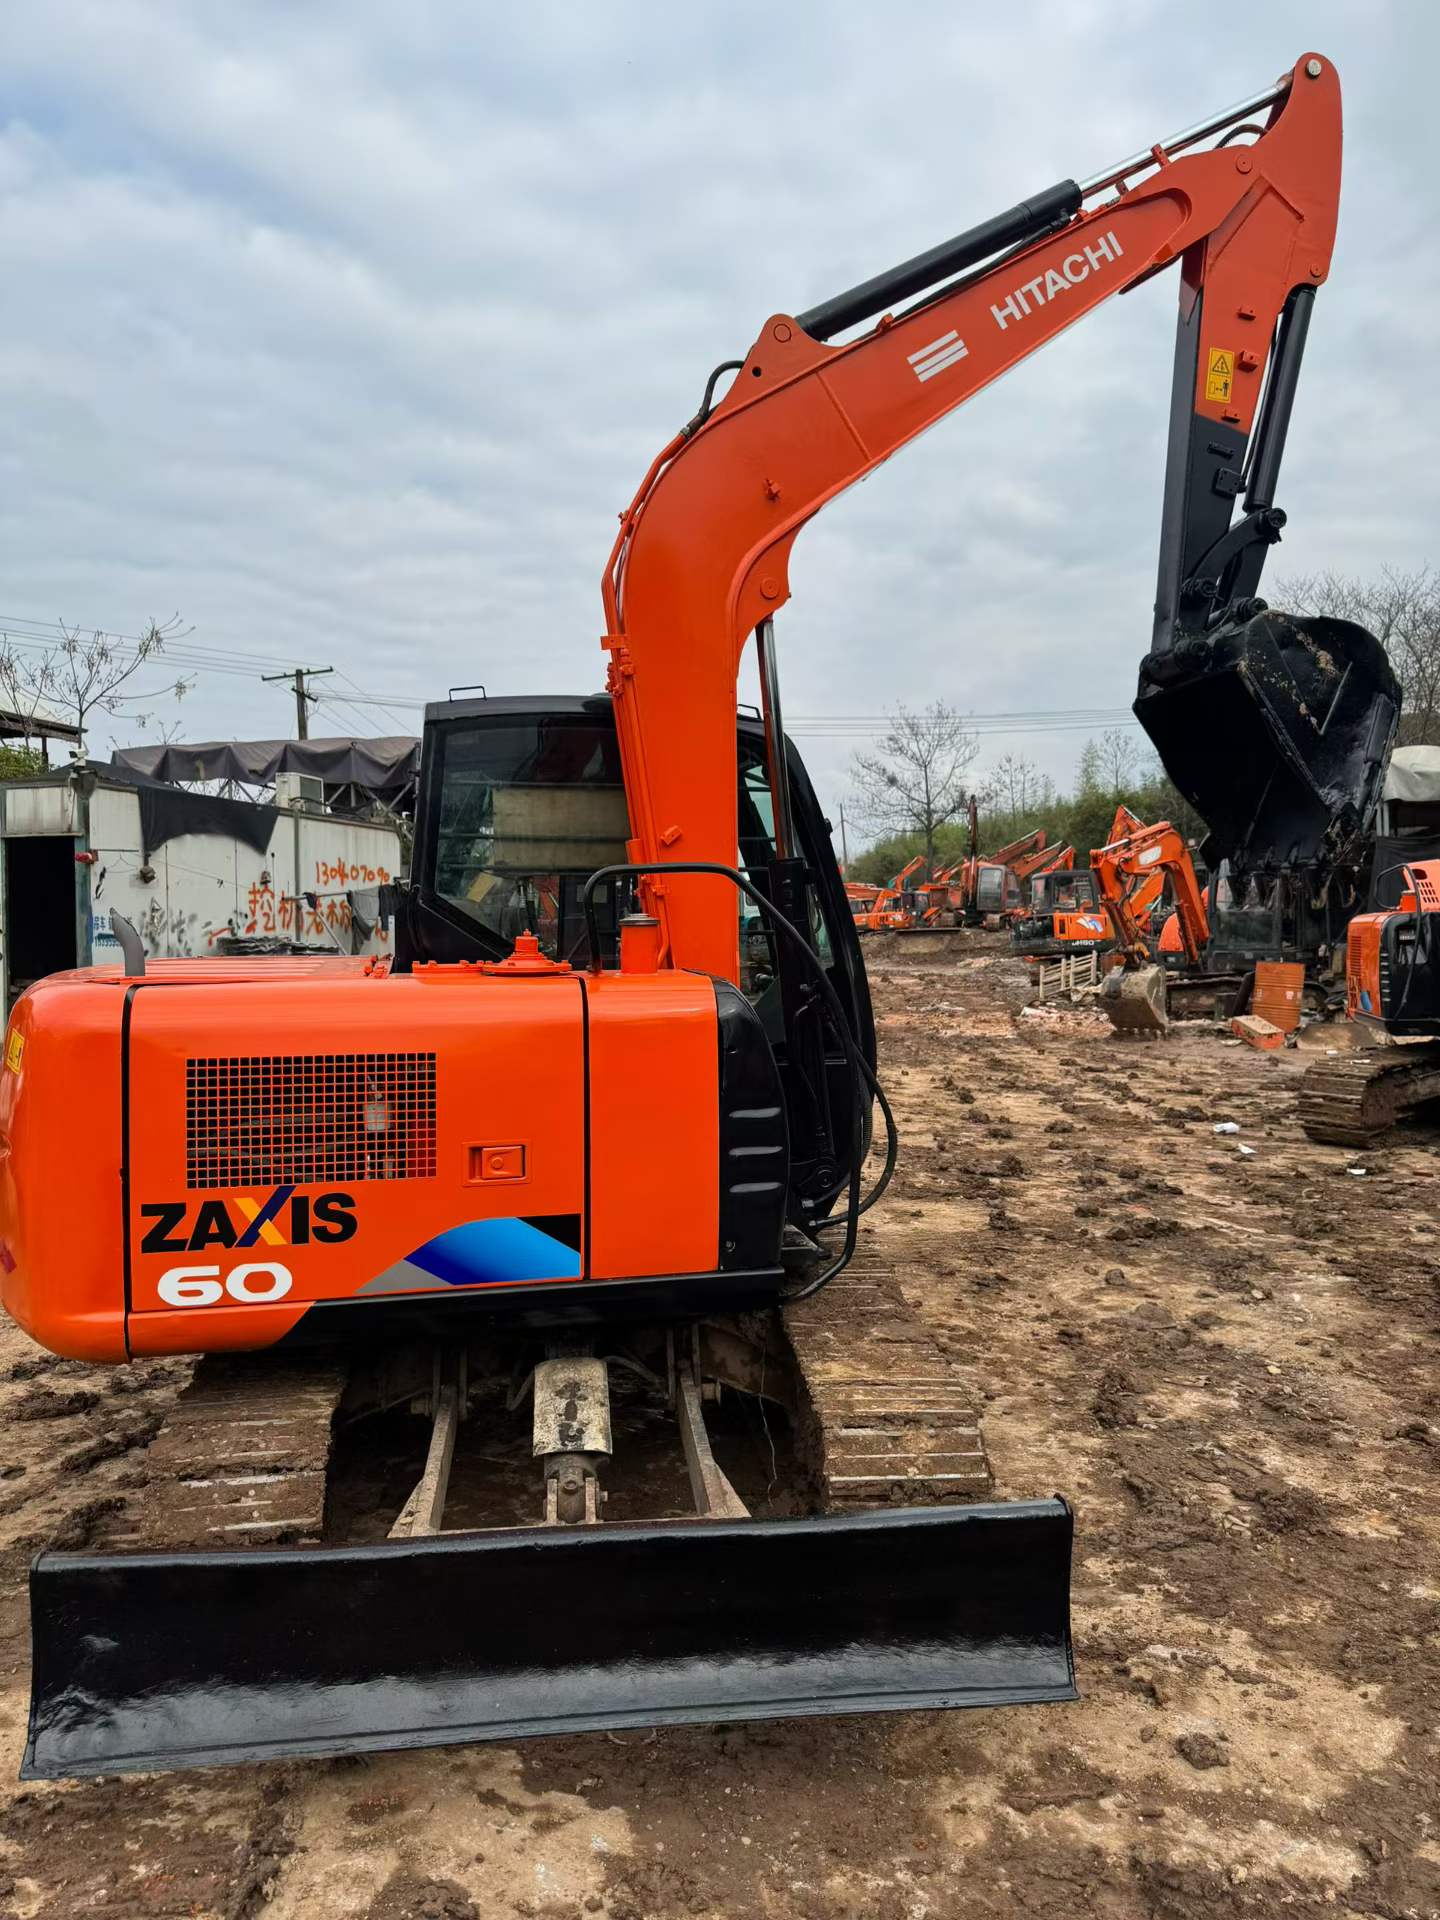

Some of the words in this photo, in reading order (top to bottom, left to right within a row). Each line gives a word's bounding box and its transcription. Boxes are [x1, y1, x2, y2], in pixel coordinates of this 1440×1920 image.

[990, 231, 1124, 330] HITACHI
[141, 1185, 358, 1254] ZAXIS
[157, 1262, 293, 1306] 60
